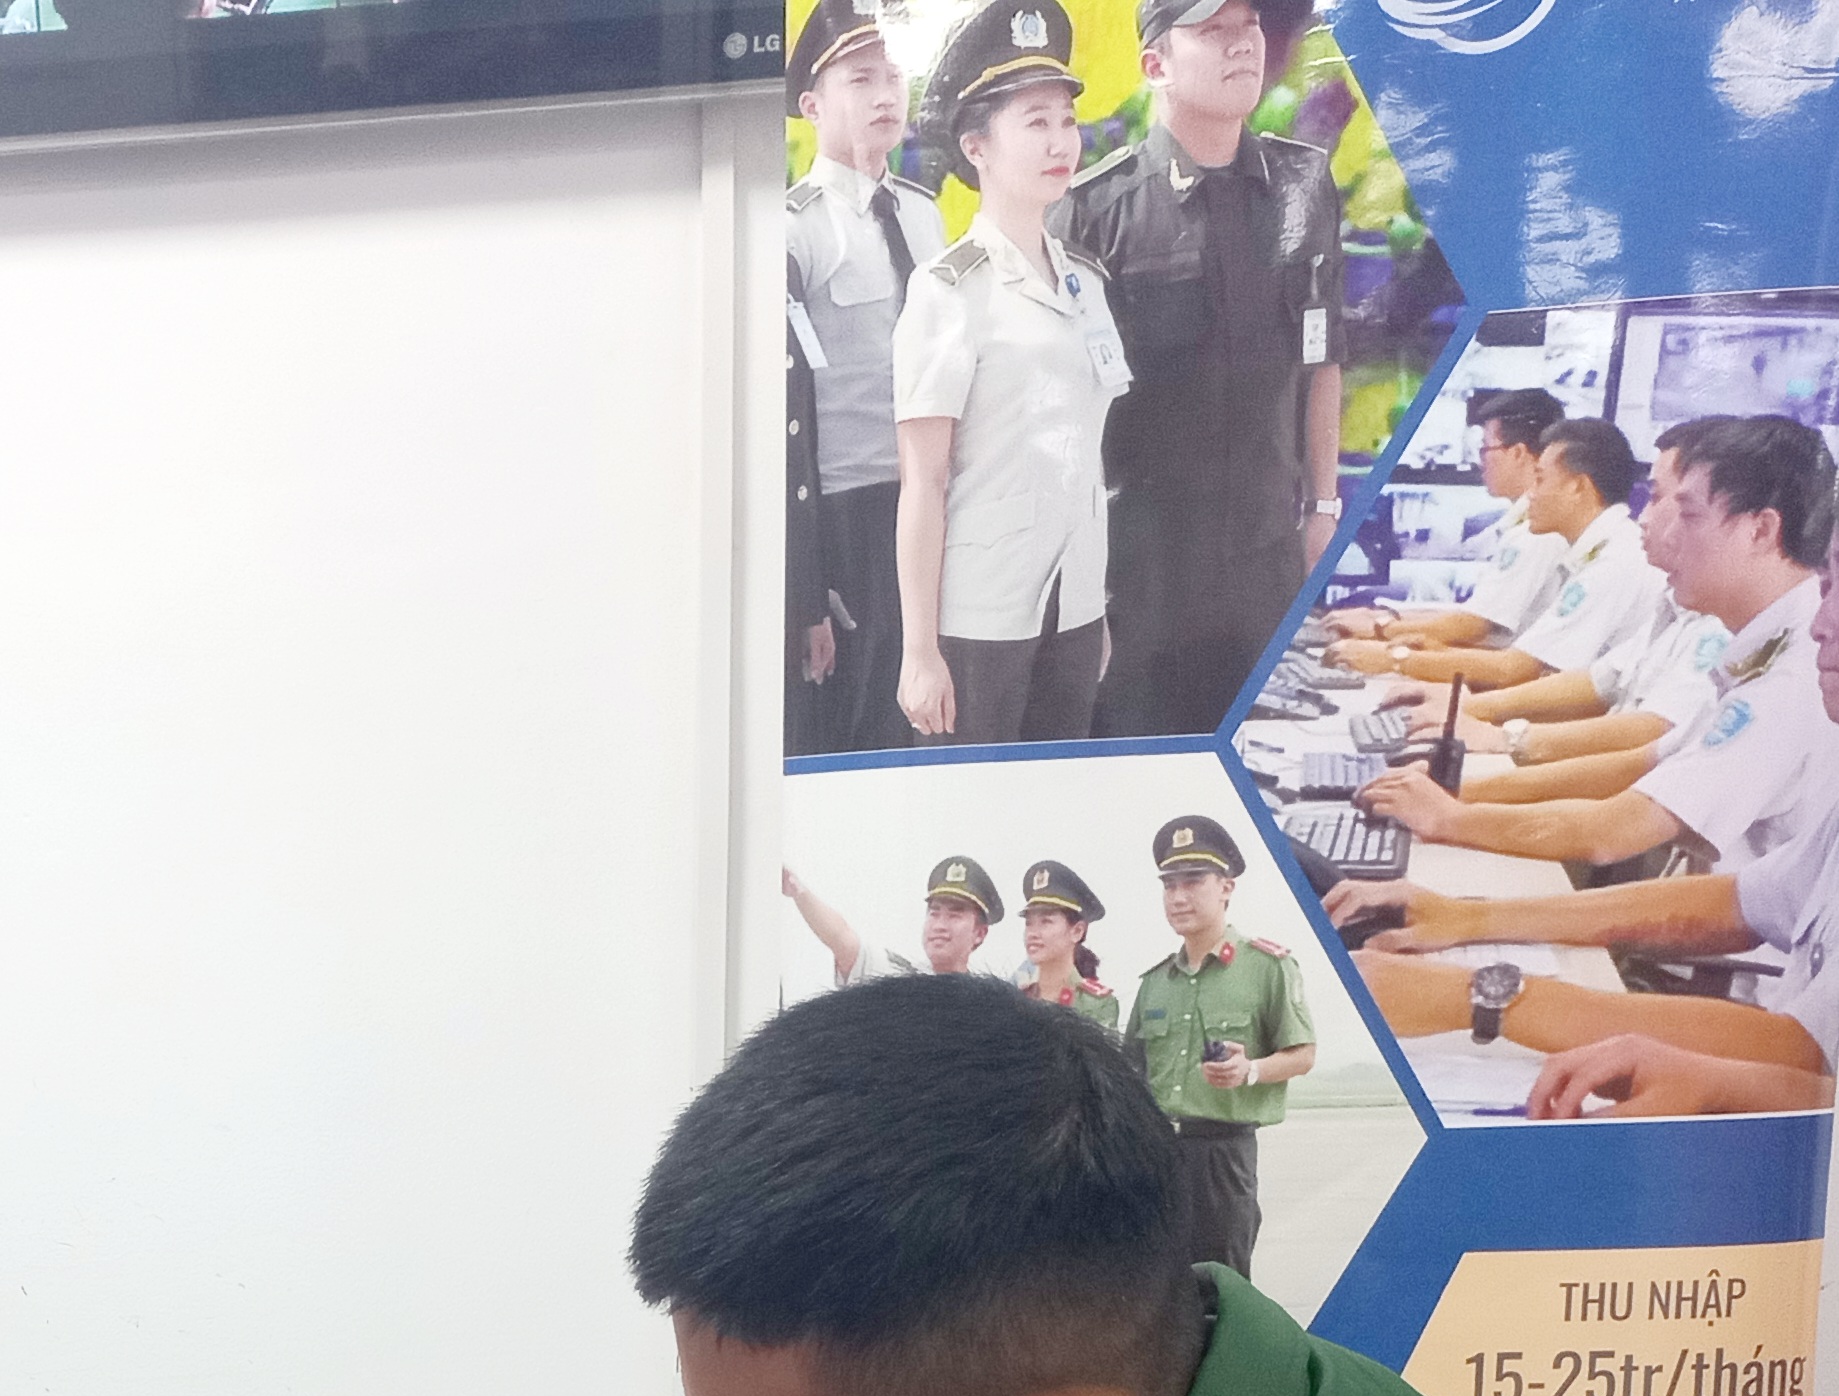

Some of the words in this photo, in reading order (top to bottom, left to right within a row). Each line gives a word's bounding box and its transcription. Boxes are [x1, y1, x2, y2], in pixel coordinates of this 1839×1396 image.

[753, 34, 780, 53] LG
[1560, 1281, 1634, 1322] THU
[1648, 1268, 1747, 1327] NHẬP
